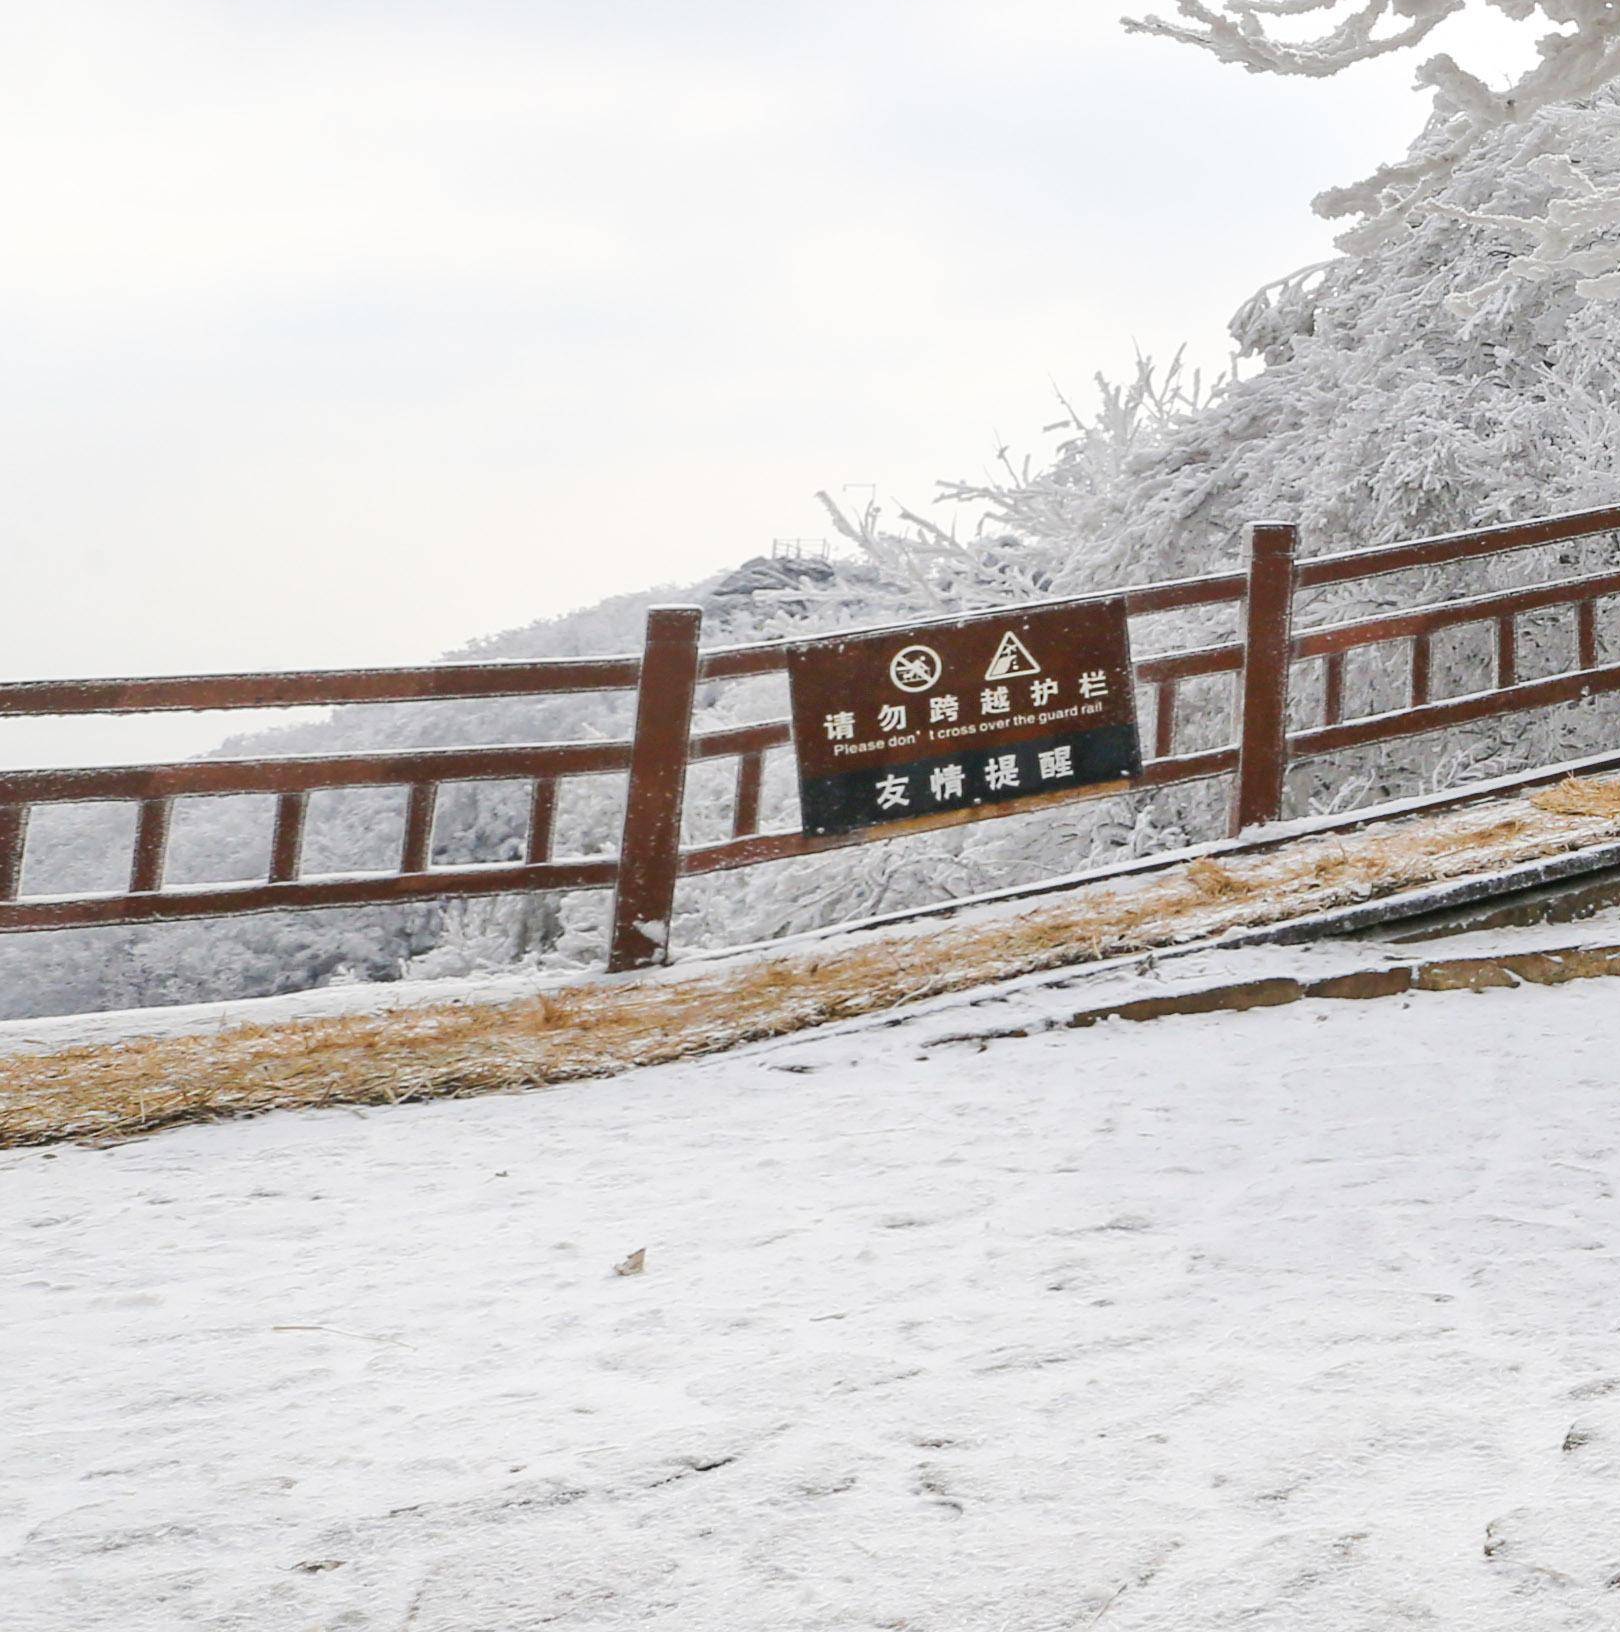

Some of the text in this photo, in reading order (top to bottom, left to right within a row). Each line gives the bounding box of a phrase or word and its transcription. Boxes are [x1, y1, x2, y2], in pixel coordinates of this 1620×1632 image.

[823, 670, 1109, 740] 请勿跨越护栏
[834, 739, 885, 756] Please
[937, 724, 977, 740] cross
[979, 718, 1011, 732] over
[1013, 714, 1036, 726] the
[1038, 705, 1079, 725] guard
[1081, 701, 1103, 715] rail
[875, 745, 1074, 810] 友情提醒
